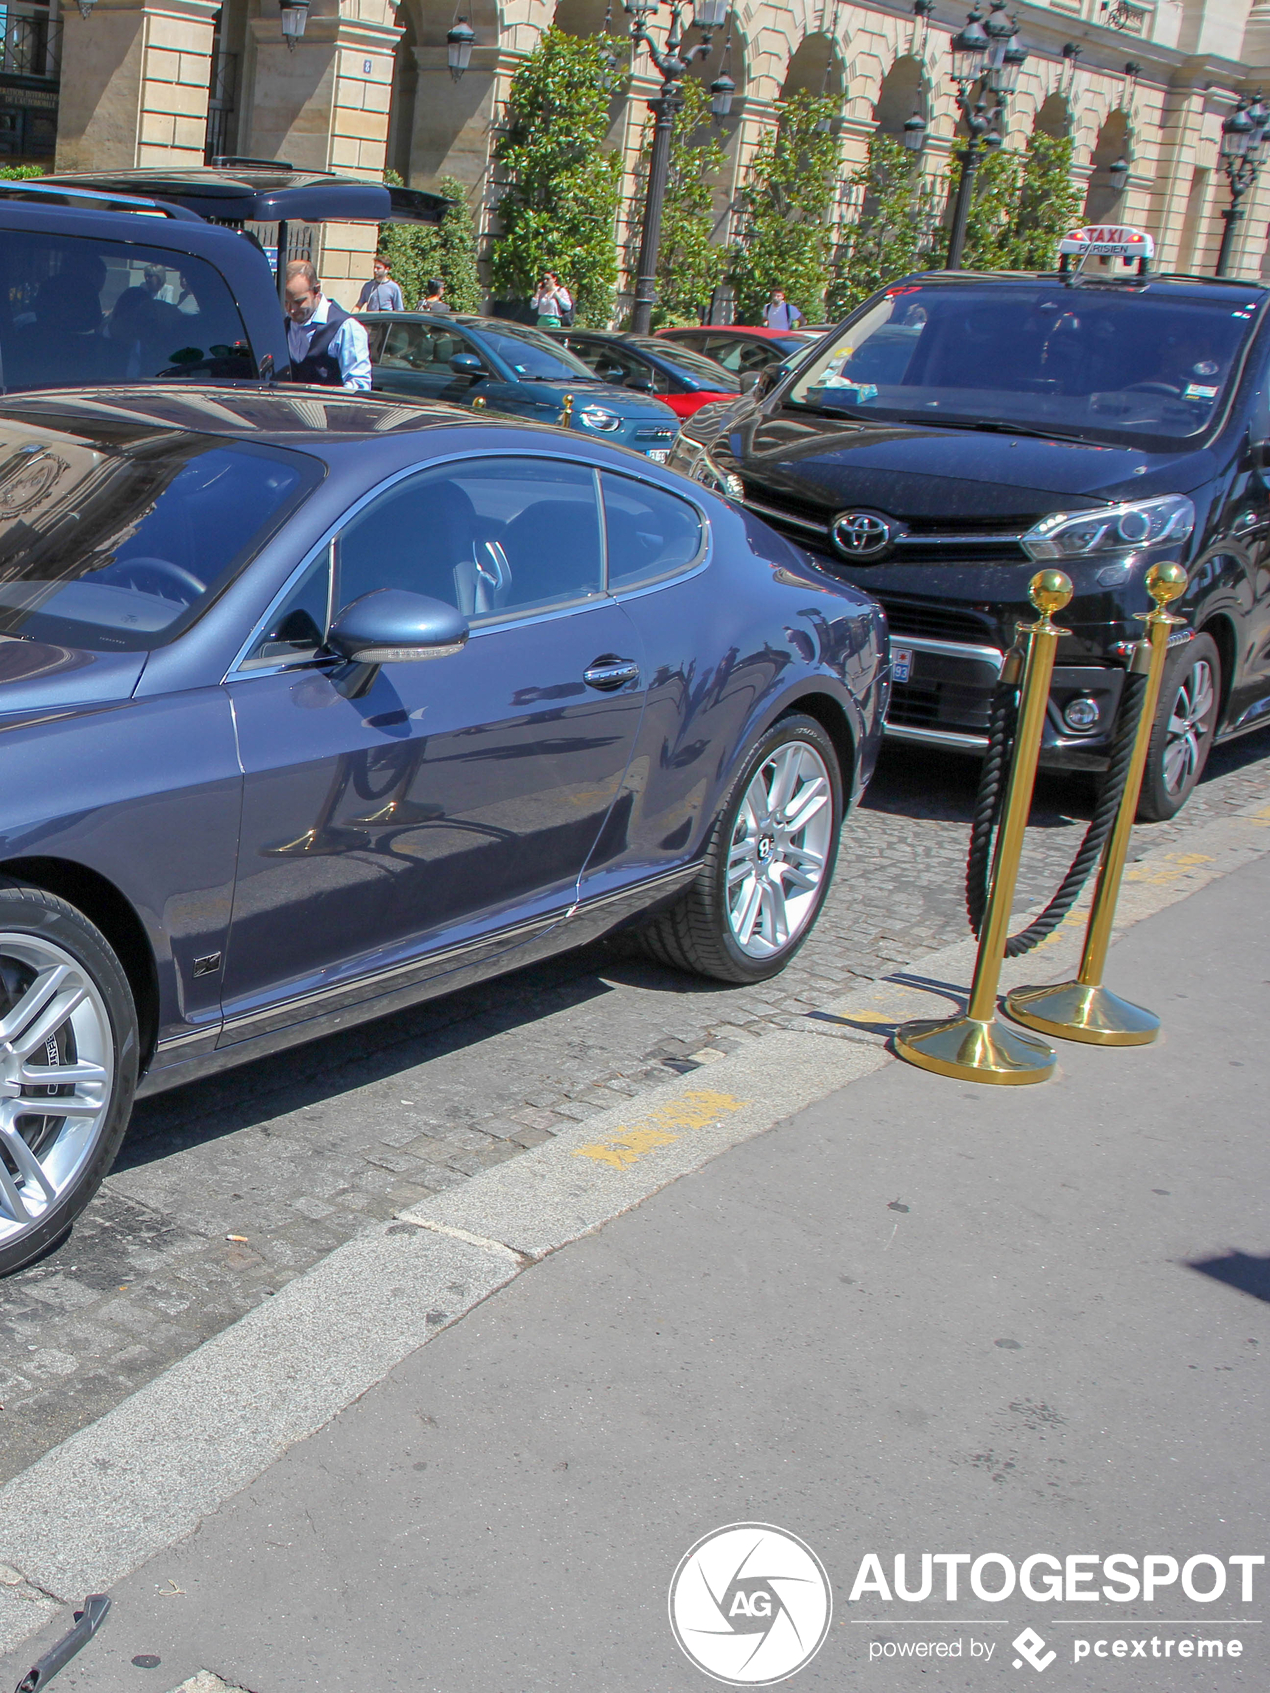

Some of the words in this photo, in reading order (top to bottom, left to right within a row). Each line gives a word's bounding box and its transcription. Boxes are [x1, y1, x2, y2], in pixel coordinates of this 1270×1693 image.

[1086, 228, 1125, 243] TAXI
[1079, 244, 1129, 253] PARISIEN
[895, 666, 908, 678] 93
